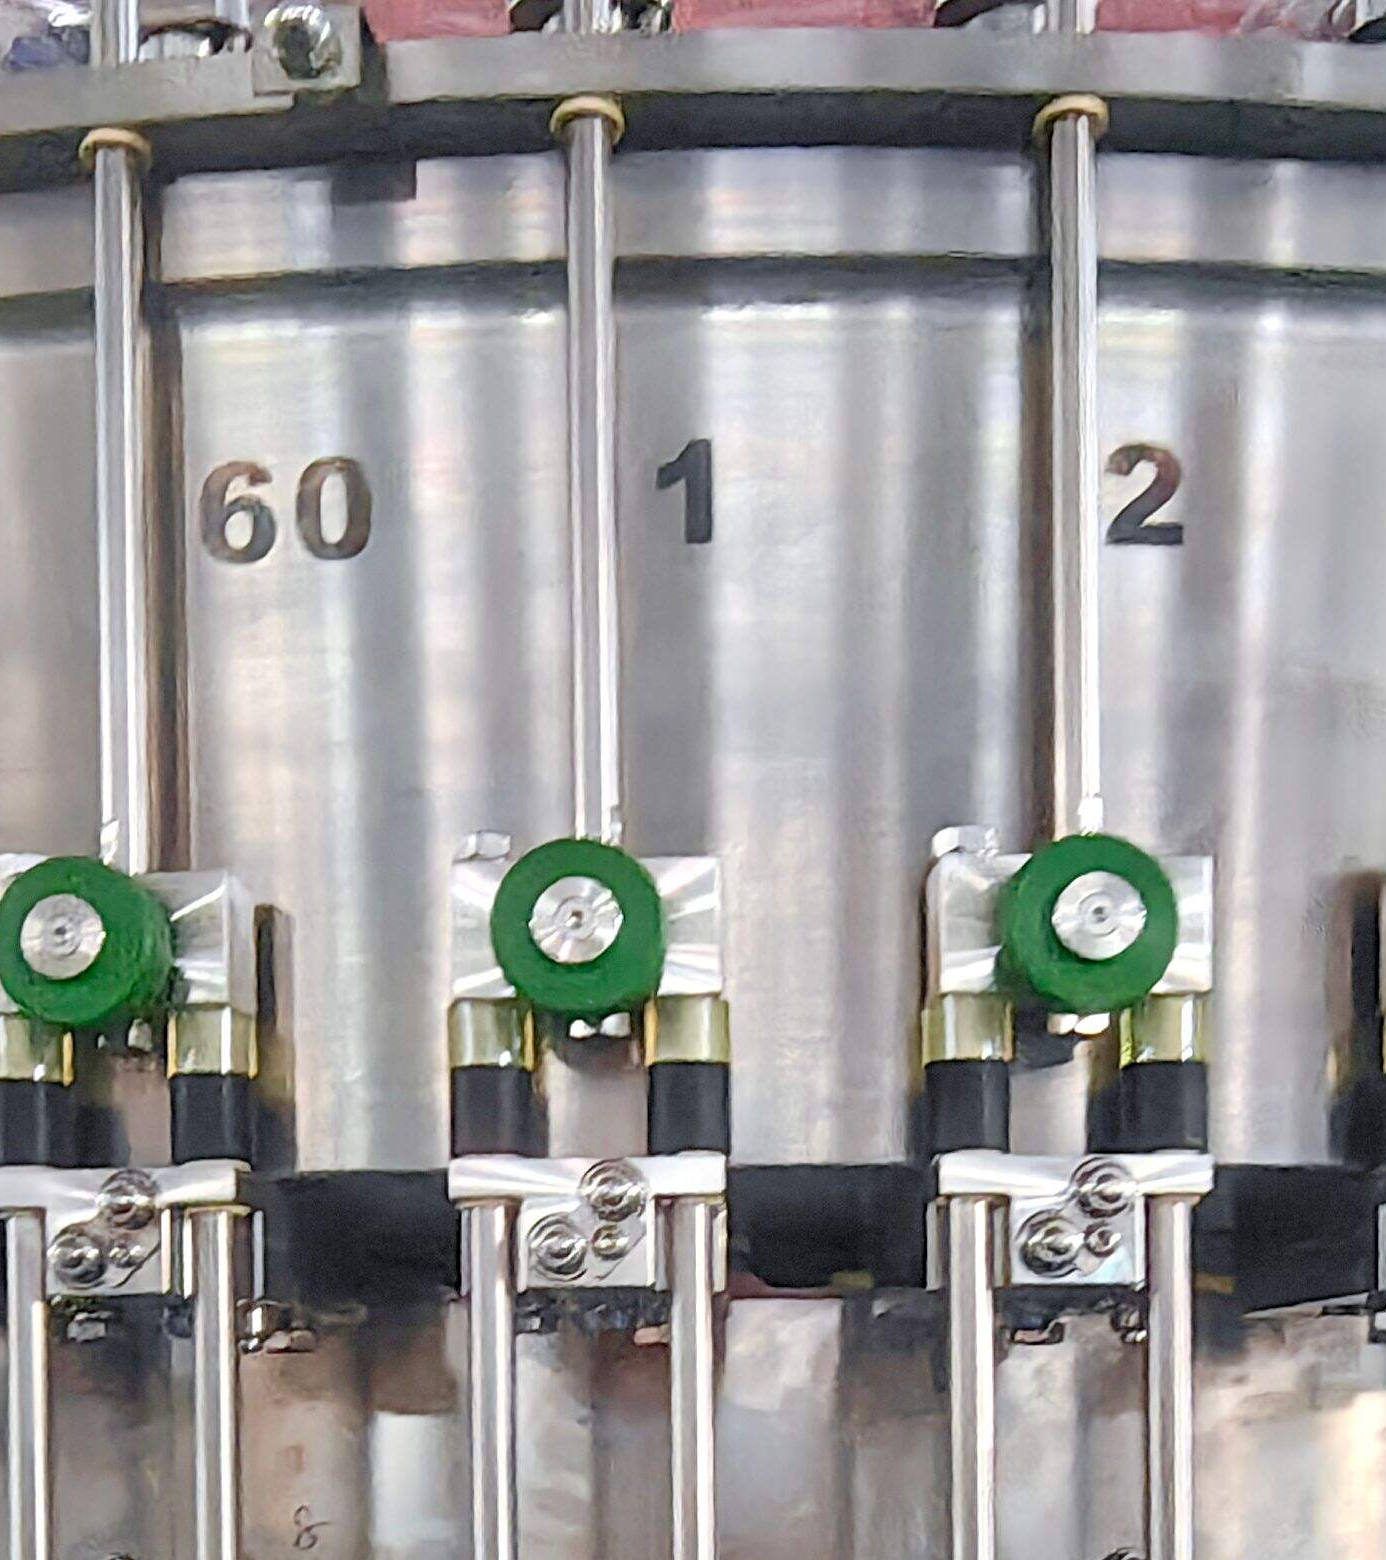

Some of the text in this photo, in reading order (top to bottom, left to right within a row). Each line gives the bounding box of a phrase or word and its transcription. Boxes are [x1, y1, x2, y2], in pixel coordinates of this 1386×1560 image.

[198, 456, 373, 564] 60
[655, 439, 714, 546] 1
[1105, 442, 1184, 547] 2
